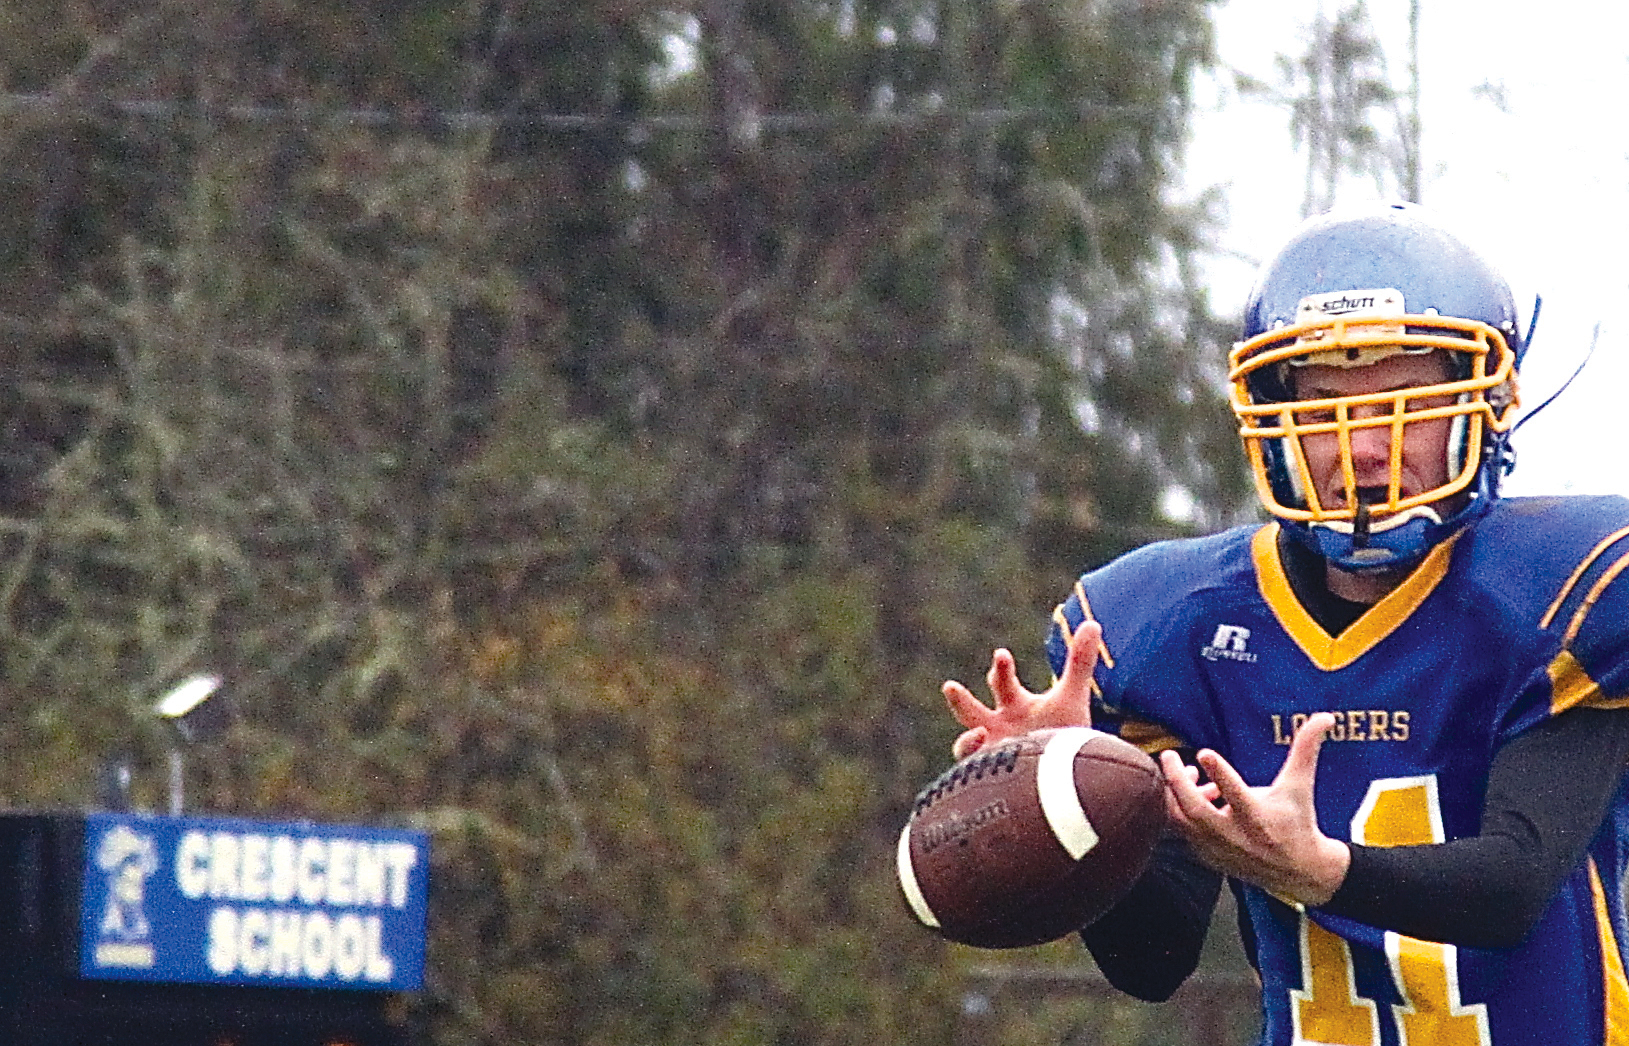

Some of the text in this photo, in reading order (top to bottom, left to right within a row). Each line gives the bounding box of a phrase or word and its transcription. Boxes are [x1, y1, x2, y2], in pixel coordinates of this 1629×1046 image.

[1320, 296, 1375, 312] schutt
[1212, 624, 1251, 652] R
[1271, 710, 1411, 745] LGERS
[175, 830, 418, 908] CRESCENT
[207, 906, 393, 983] SCHOOL
